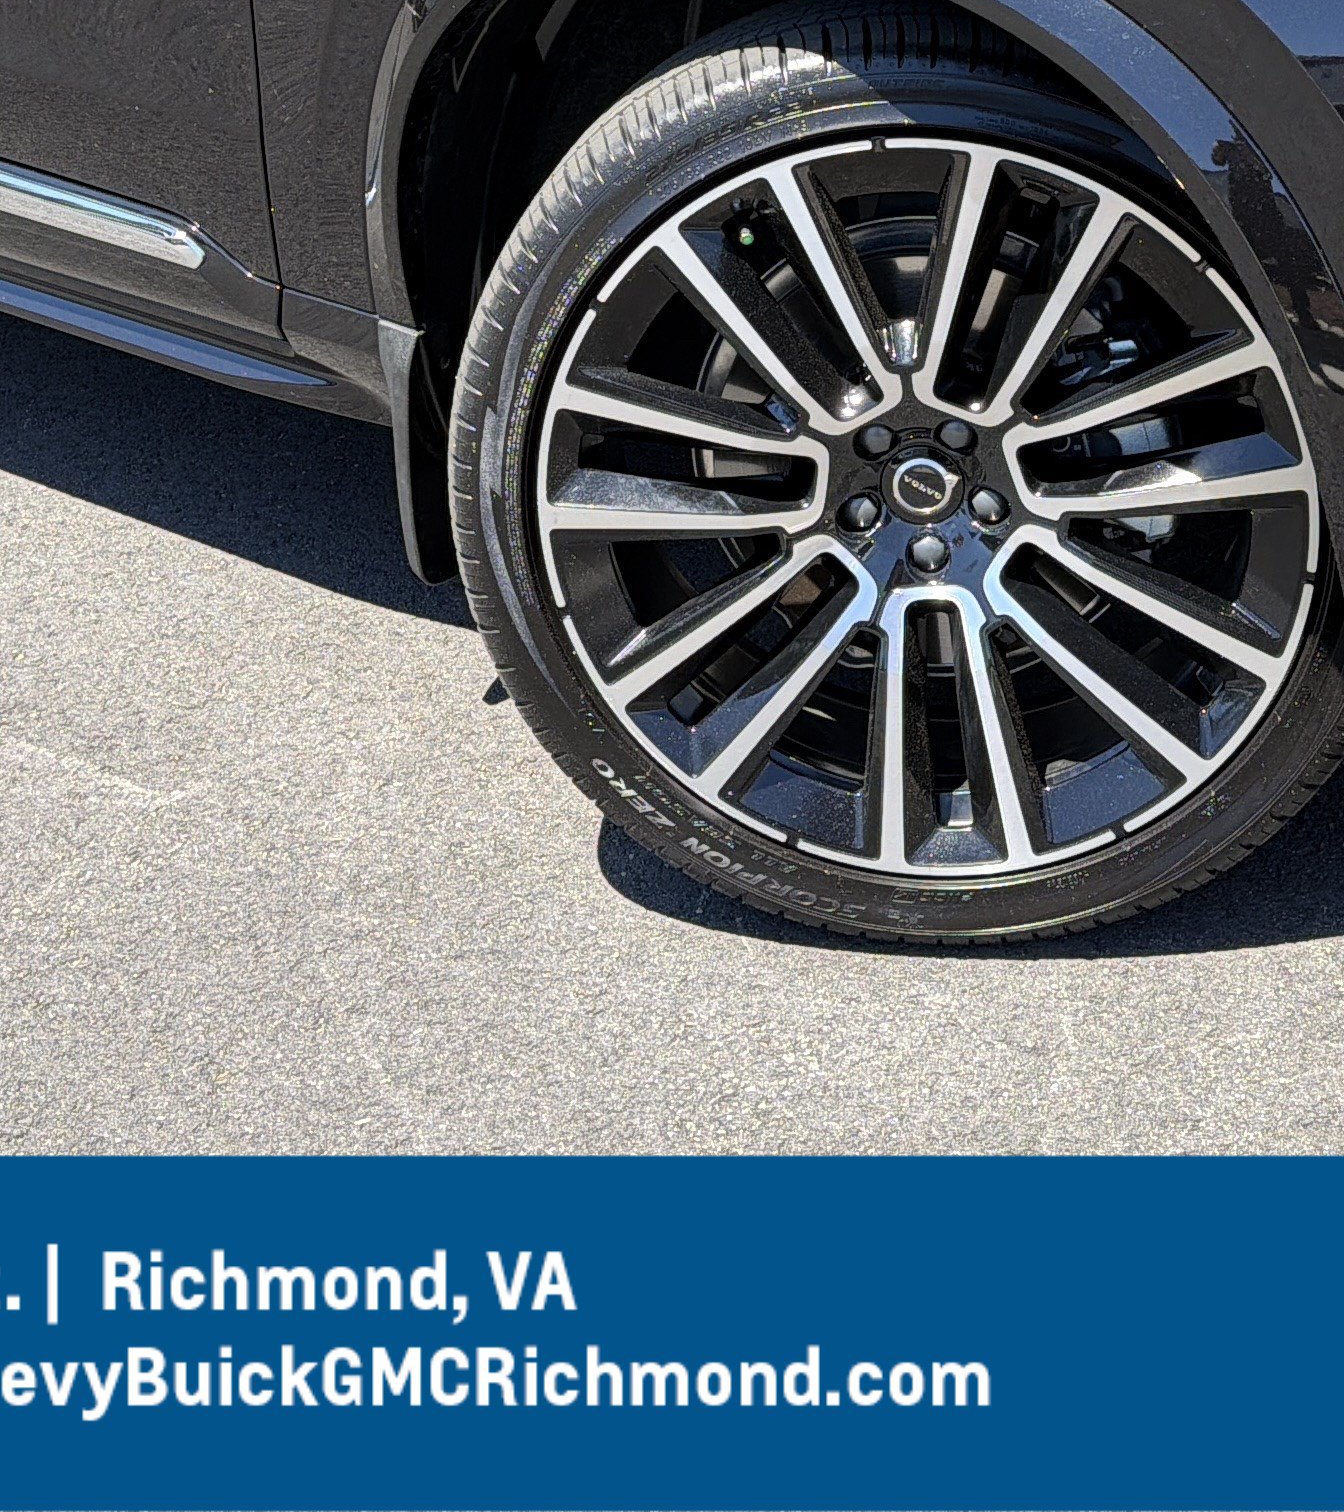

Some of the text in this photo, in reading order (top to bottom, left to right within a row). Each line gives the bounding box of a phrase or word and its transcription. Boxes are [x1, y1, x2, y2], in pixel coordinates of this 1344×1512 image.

[903, 474, 943, 500] VOLVO
[590, 757, 677, 837] ZERO
[679, 836, 867, 917] SCORPION
